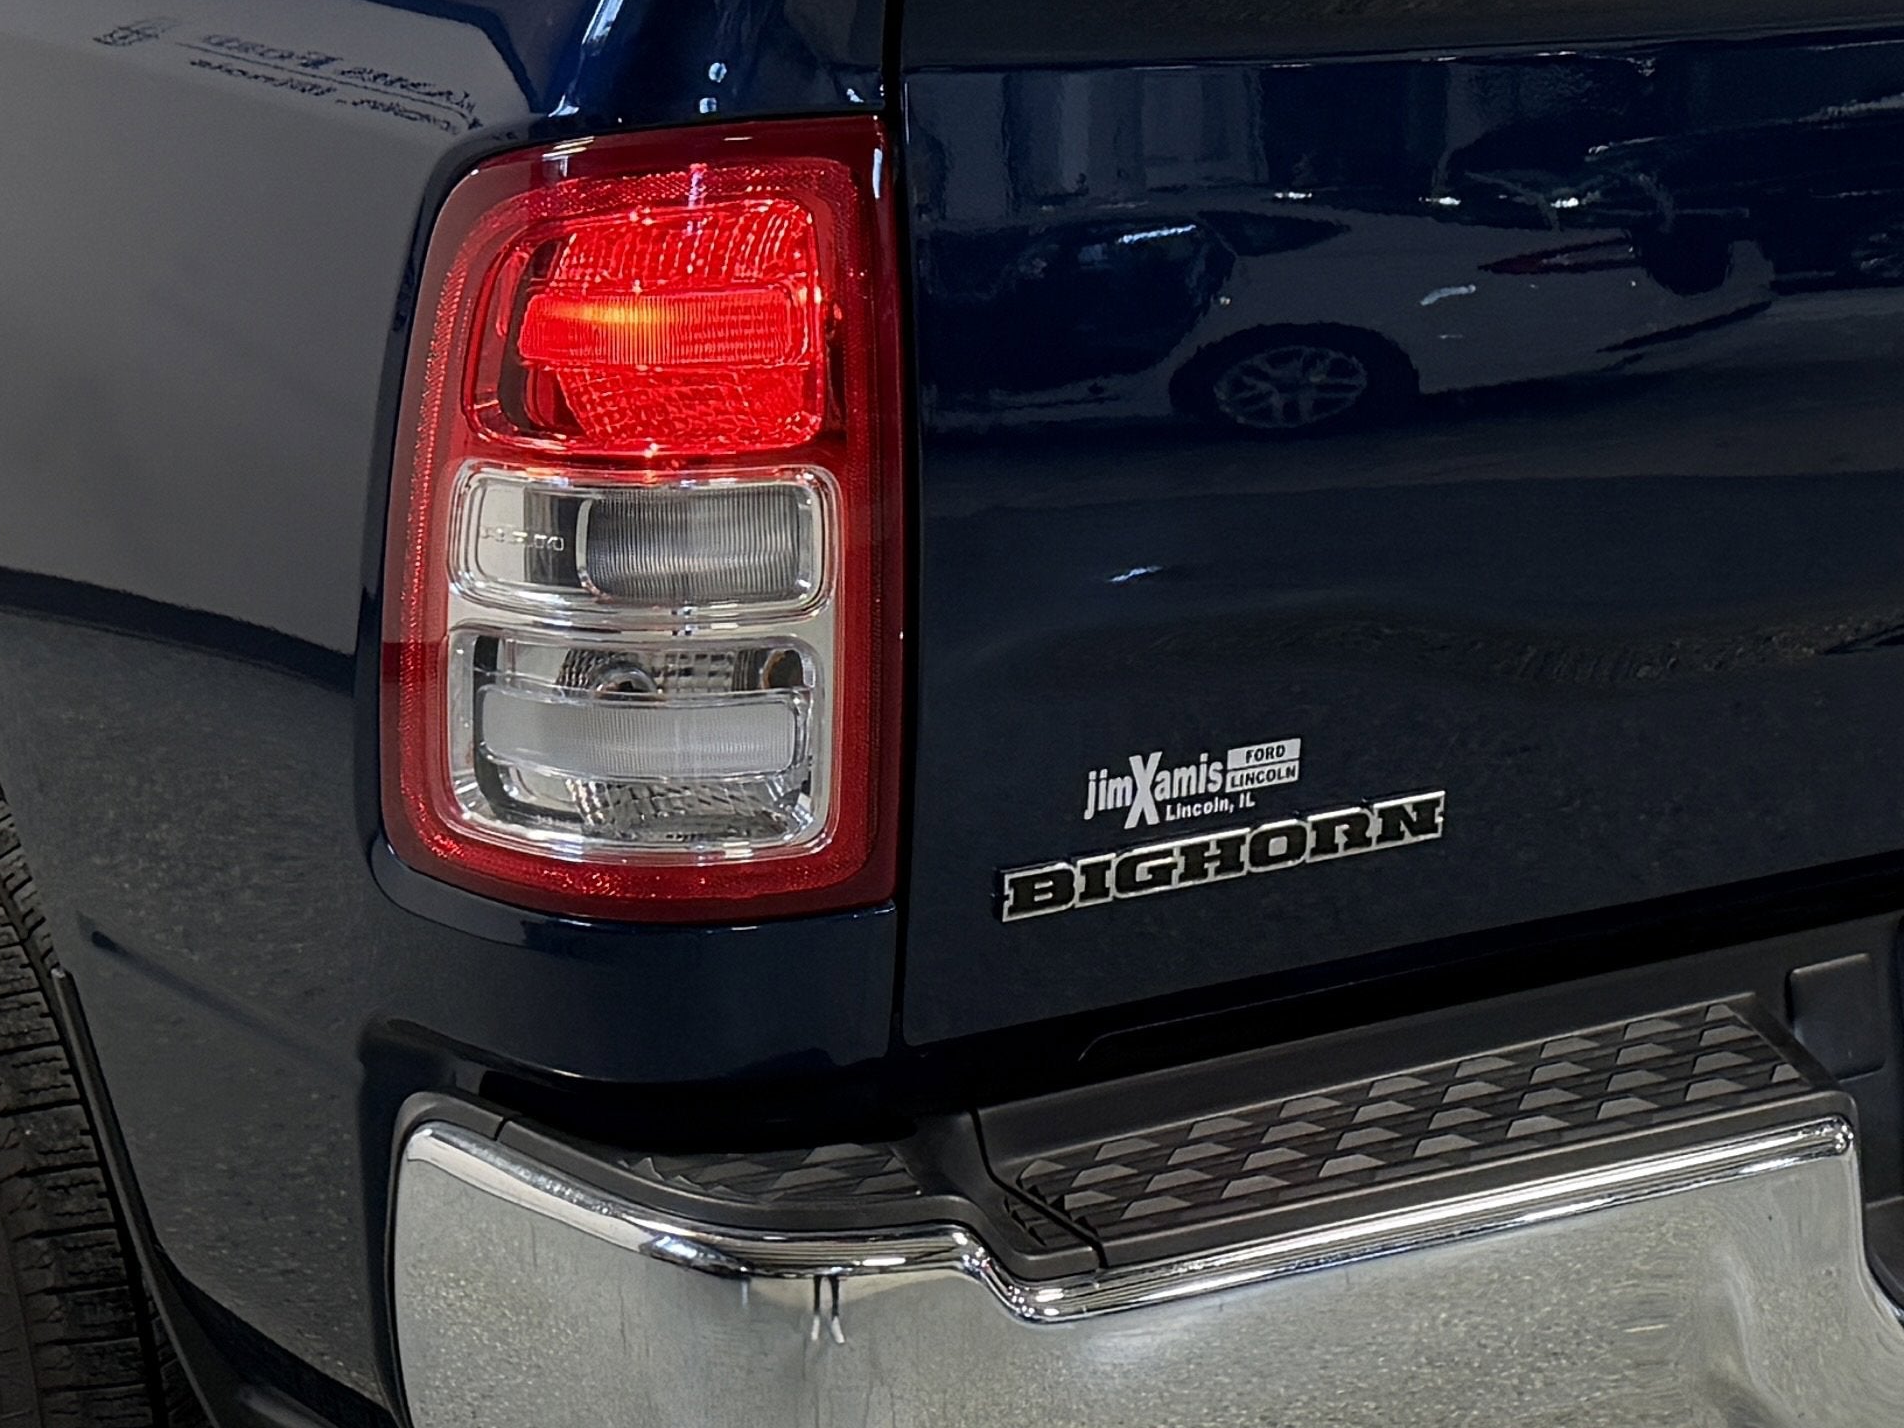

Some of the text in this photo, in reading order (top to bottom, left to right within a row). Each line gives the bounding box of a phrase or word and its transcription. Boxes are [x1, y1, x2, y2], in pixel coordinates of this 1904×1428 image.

[1245, 744, 1286, 763] FORD
[1084, 751, 1224, 830] jimXamis
[1229, 765, 1297, 788] LINCOLN
[1165, 792, 1256, 821] Lincoln, IL
[1001, 790, 1446, 923] BIGHORN
